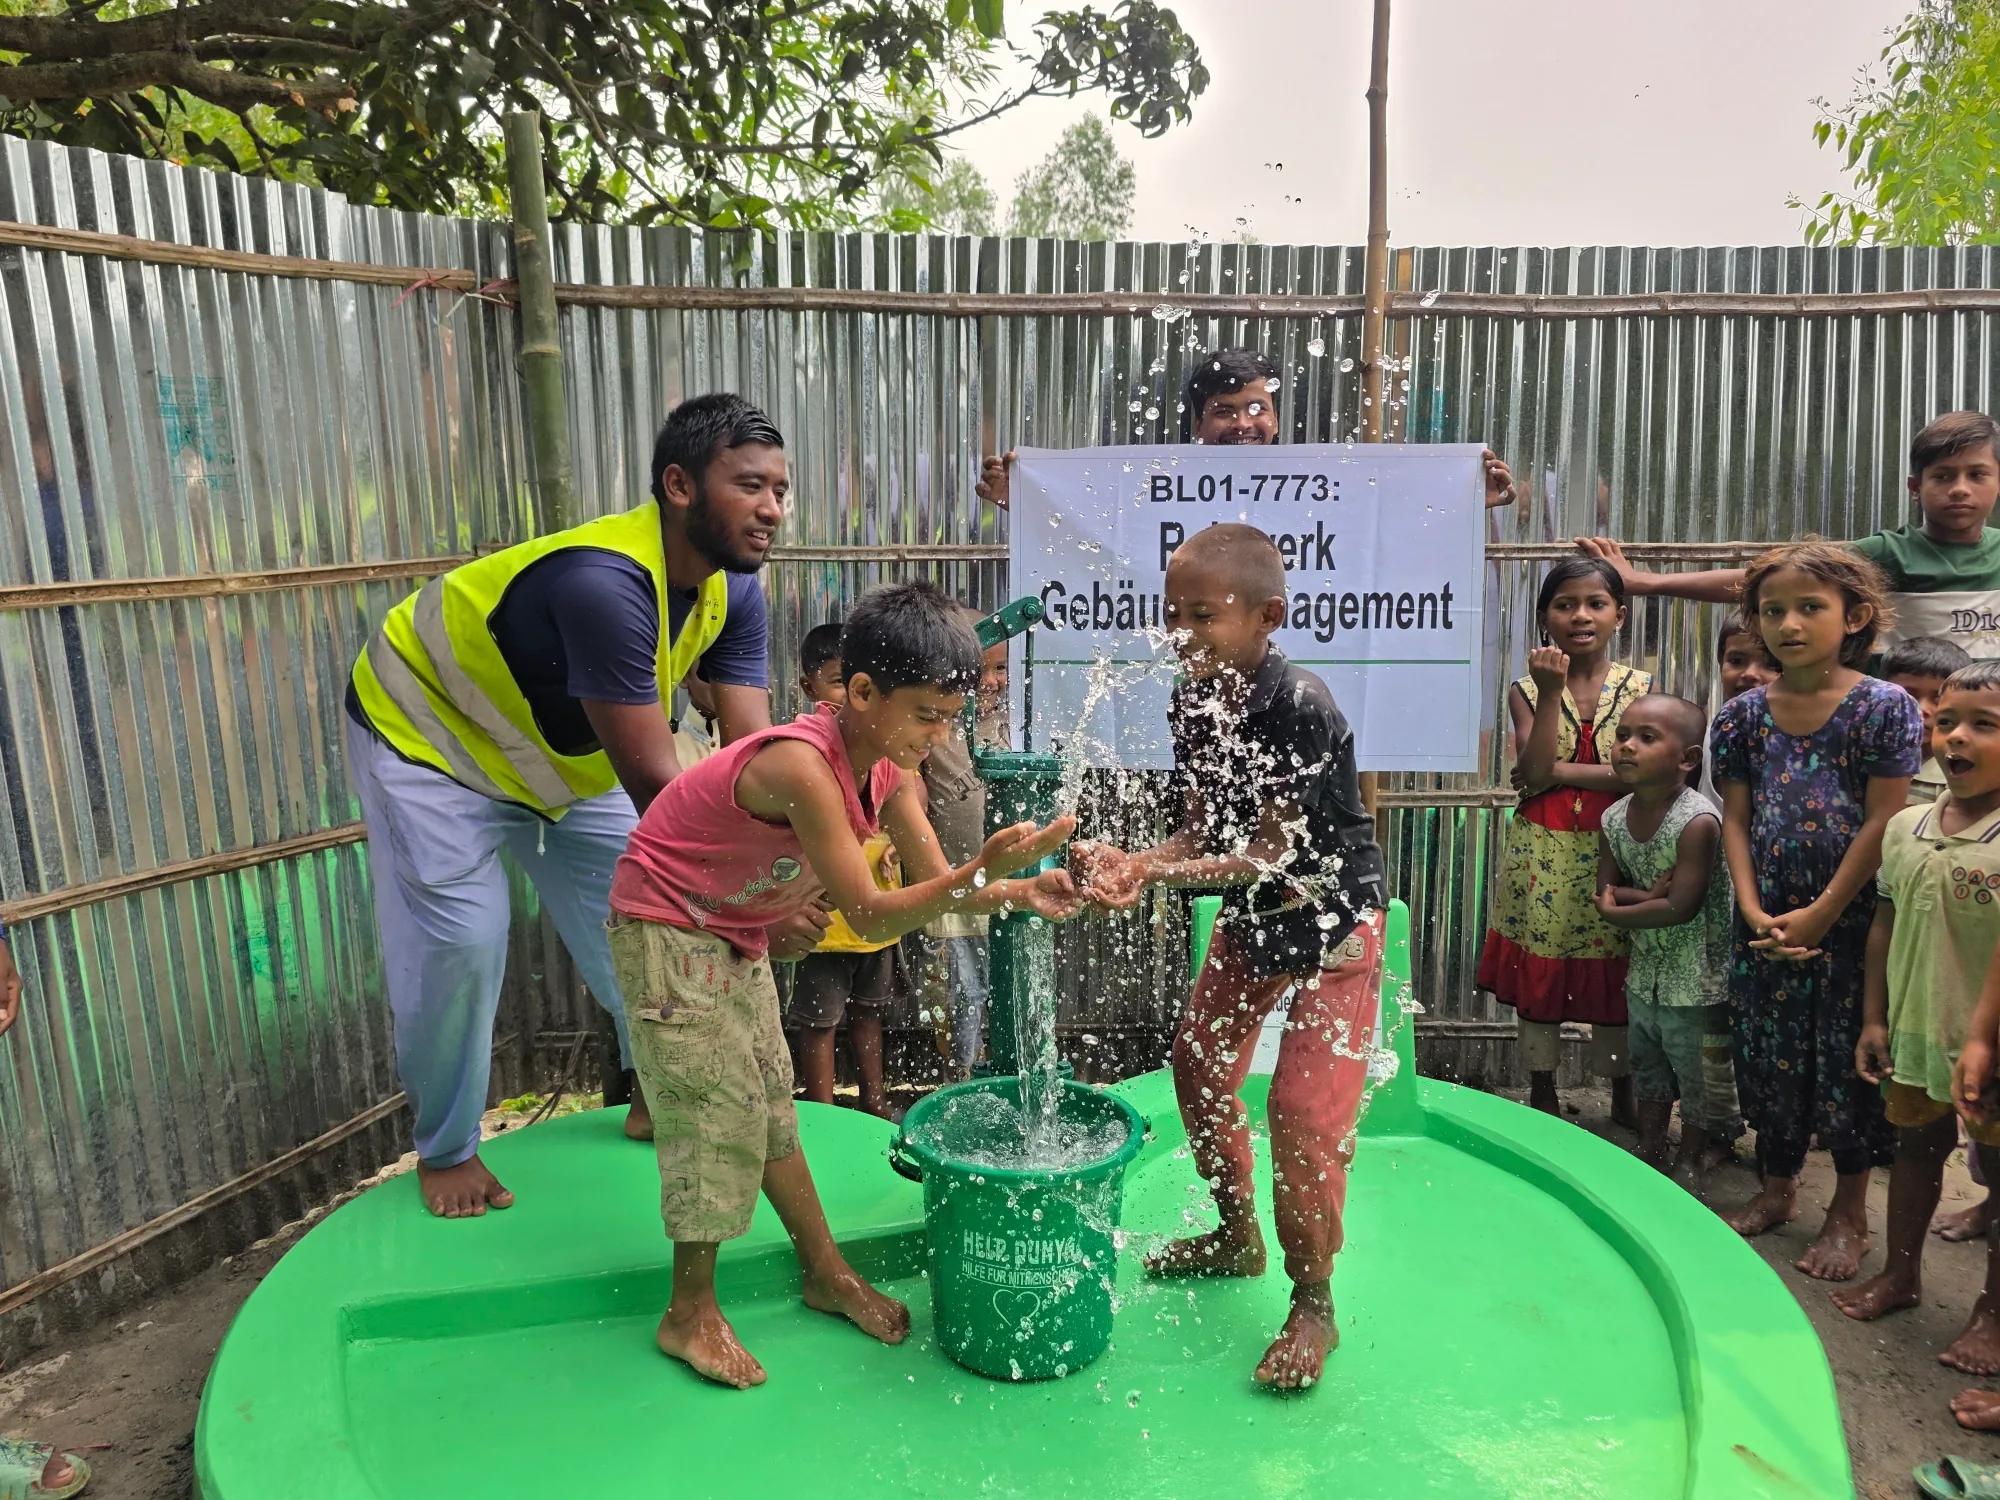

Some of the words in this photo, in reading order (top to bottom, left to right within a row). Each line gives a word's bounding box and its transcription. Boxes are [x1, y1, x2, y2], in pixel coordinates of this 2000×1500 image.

[1150, 474, 1340, 502] BL01-7773:
[1040, 580, 1454, 644] Gebäuagement
[1950, 606, 2000, 633] Di
[963, 1229, 1007, 1262] HELP
[962, 1260, 986, 1280] HILFE
